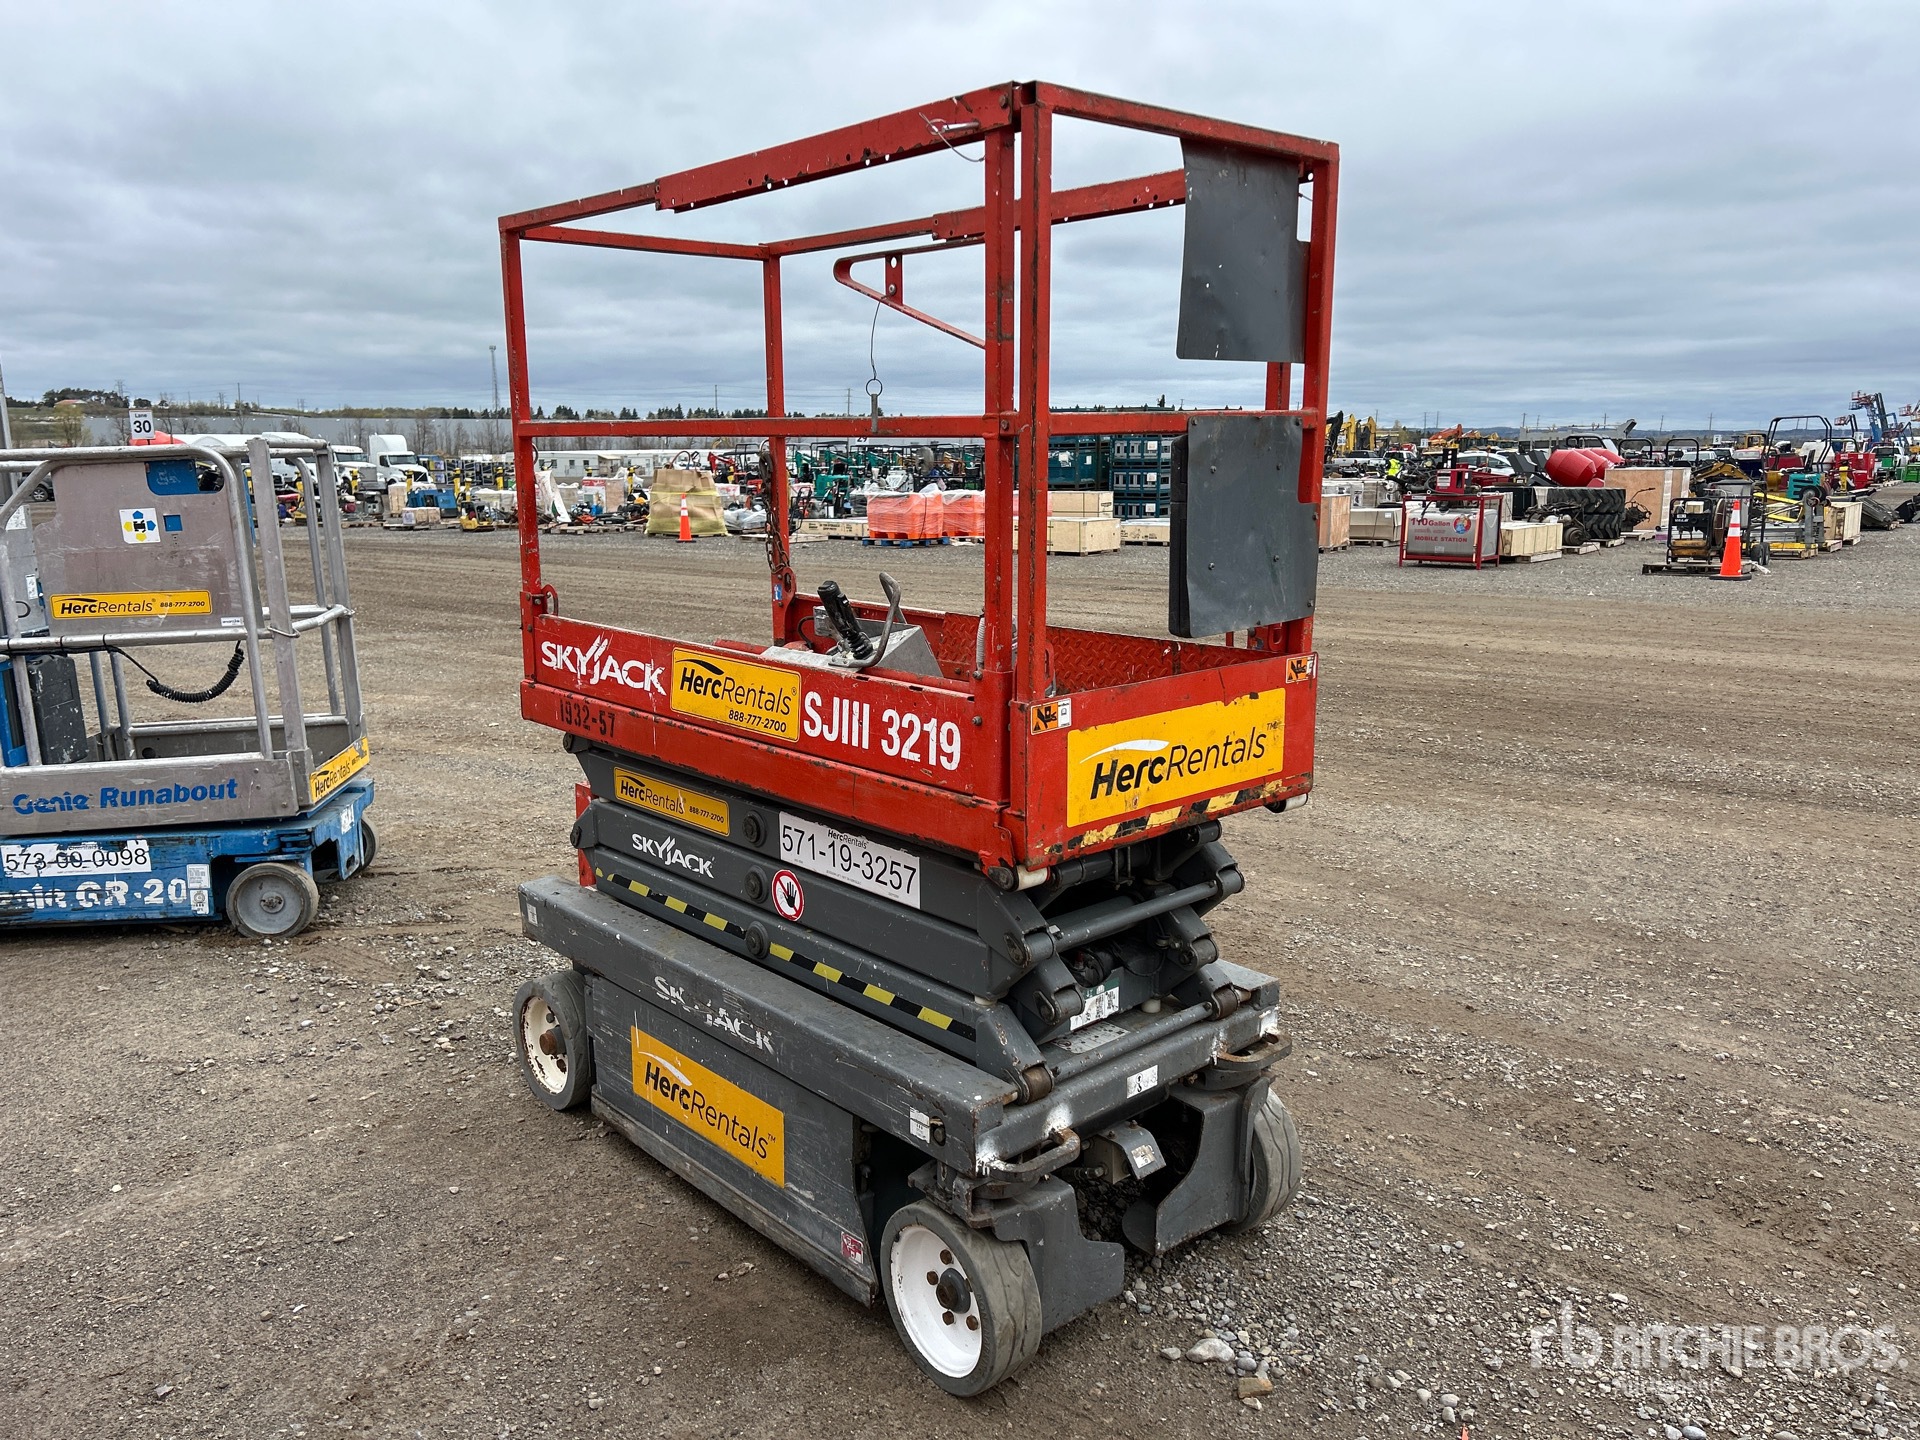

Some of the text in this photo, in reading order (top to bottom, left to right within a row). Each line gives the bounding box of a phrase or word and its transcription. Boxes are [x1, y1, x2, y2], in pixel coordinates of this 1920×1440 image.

[133, 420, 152, 433] 30
[60, 600, 205, 615] HercRentals 888-777-2700
[541, 634, 667, 696] SKYJACK
[680, 667, 792, 716] HercRentals
[560, 699, 616, 738] 1932-57
[728, 709, 787, 733] 888-777-2700
[803, 690, 961, 772] SJIII 3219
[1090, 727, 1267, 800] HercRentals
[13, 778, 238, 815] Genie Runabout
[620, 780, 725, 824] HercRentals 888-777-2700
[5, 848, 148, 872] 573-00-0098
[631, 833, 715, 879] SKYJACK
[782, 824, 917, 894] 571-19-3257
[645, 1062, 768, 1159] HercRentals
